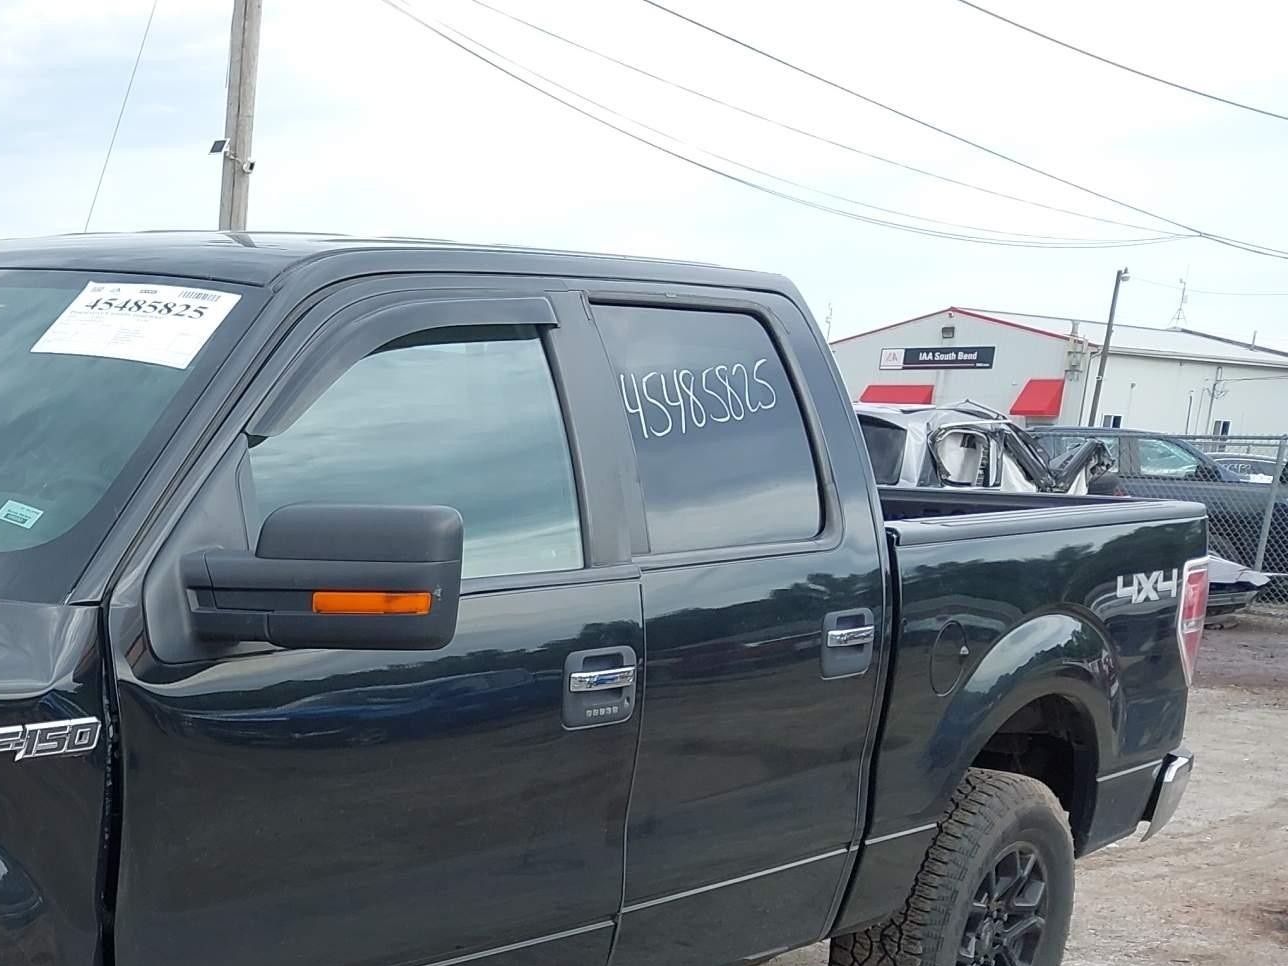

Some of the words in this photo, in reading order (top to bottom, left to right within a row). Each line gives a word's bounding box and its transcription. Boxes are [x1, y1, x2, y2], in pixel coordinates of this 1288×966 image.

[85, 297, 210, 320] 45485825
[918, 351, 933, 361] IAA
[934, 351, 957, 361] South
[957, 351, 978, 361] Bend
[620, 358, 777, 439] 45485825
[1117, 567, 1179, 604] 4X4
